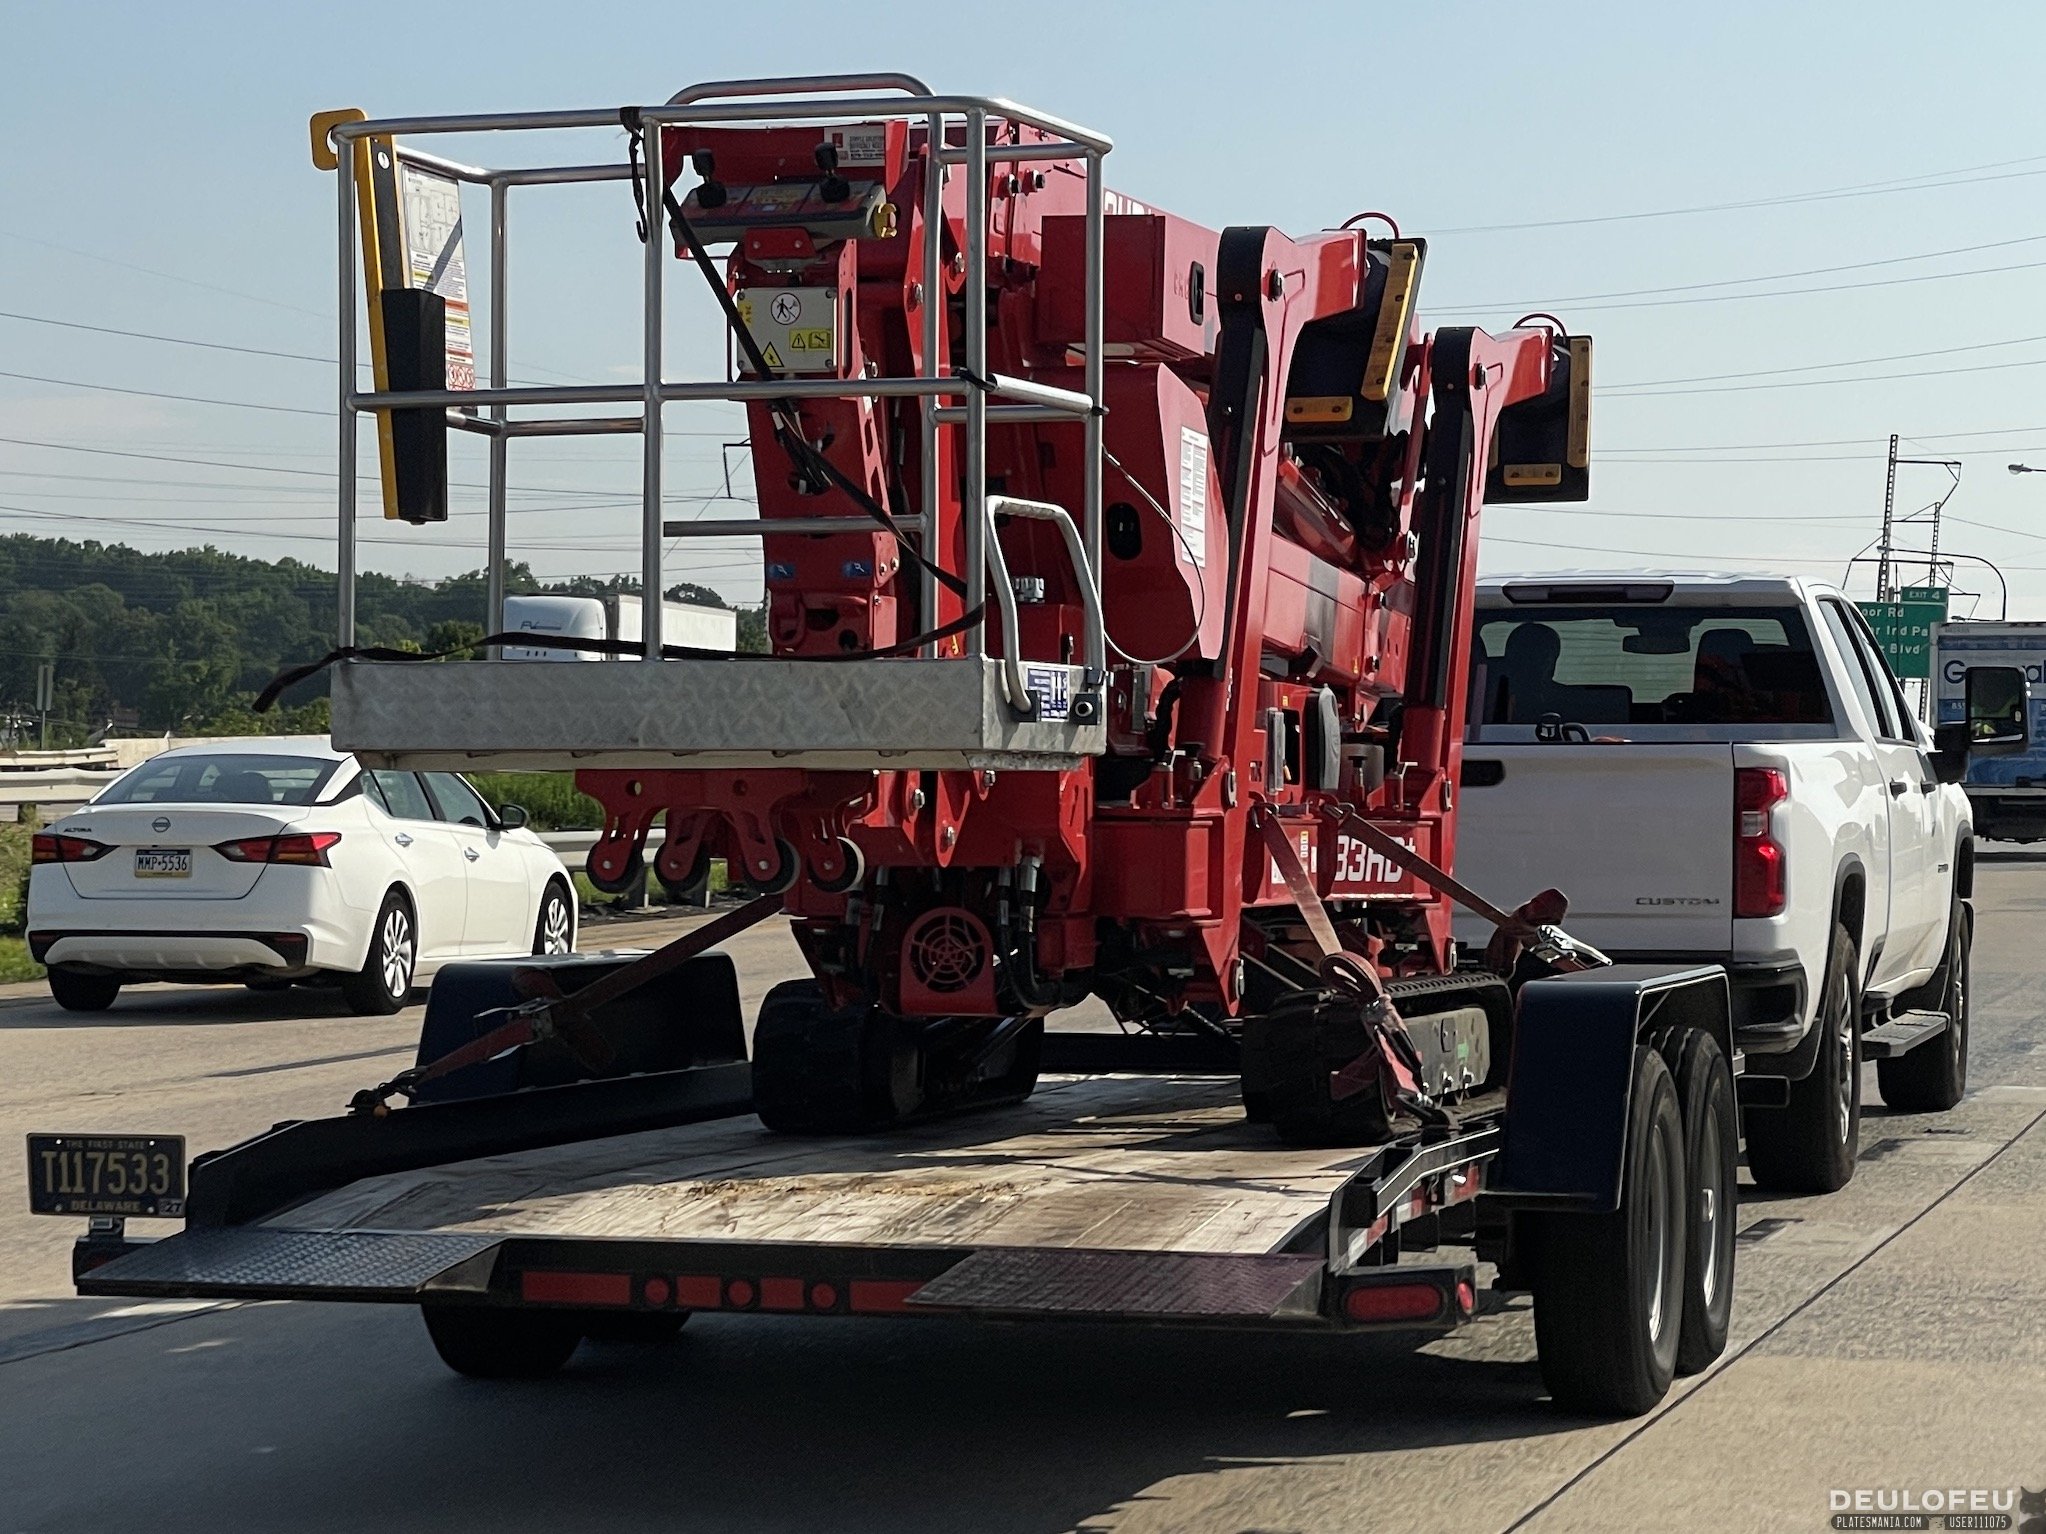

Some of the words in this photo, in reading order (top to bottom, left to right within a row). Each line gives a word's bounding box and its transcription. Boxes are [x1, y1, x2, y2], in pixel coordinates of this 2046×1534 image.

[1909, 591, 1927, 599] EXIT
[1931, 590, 1940, 600] 4
[1861, 608, 1882, 617] oor
[1887, 606, 1905, 618] Rd
[1911, 625, 1929, 637] Pa
[1889, 643, 1920, 654] Blvd
[1635, 897, 1720, 906] CUSTOM
[66, 1140, 84, 1149] THE
[117, 1141, 146, 1150] STATE
[41, 1151, 170, 1195] T117533
[70, 1201, 141, 1212] DELAWARE
